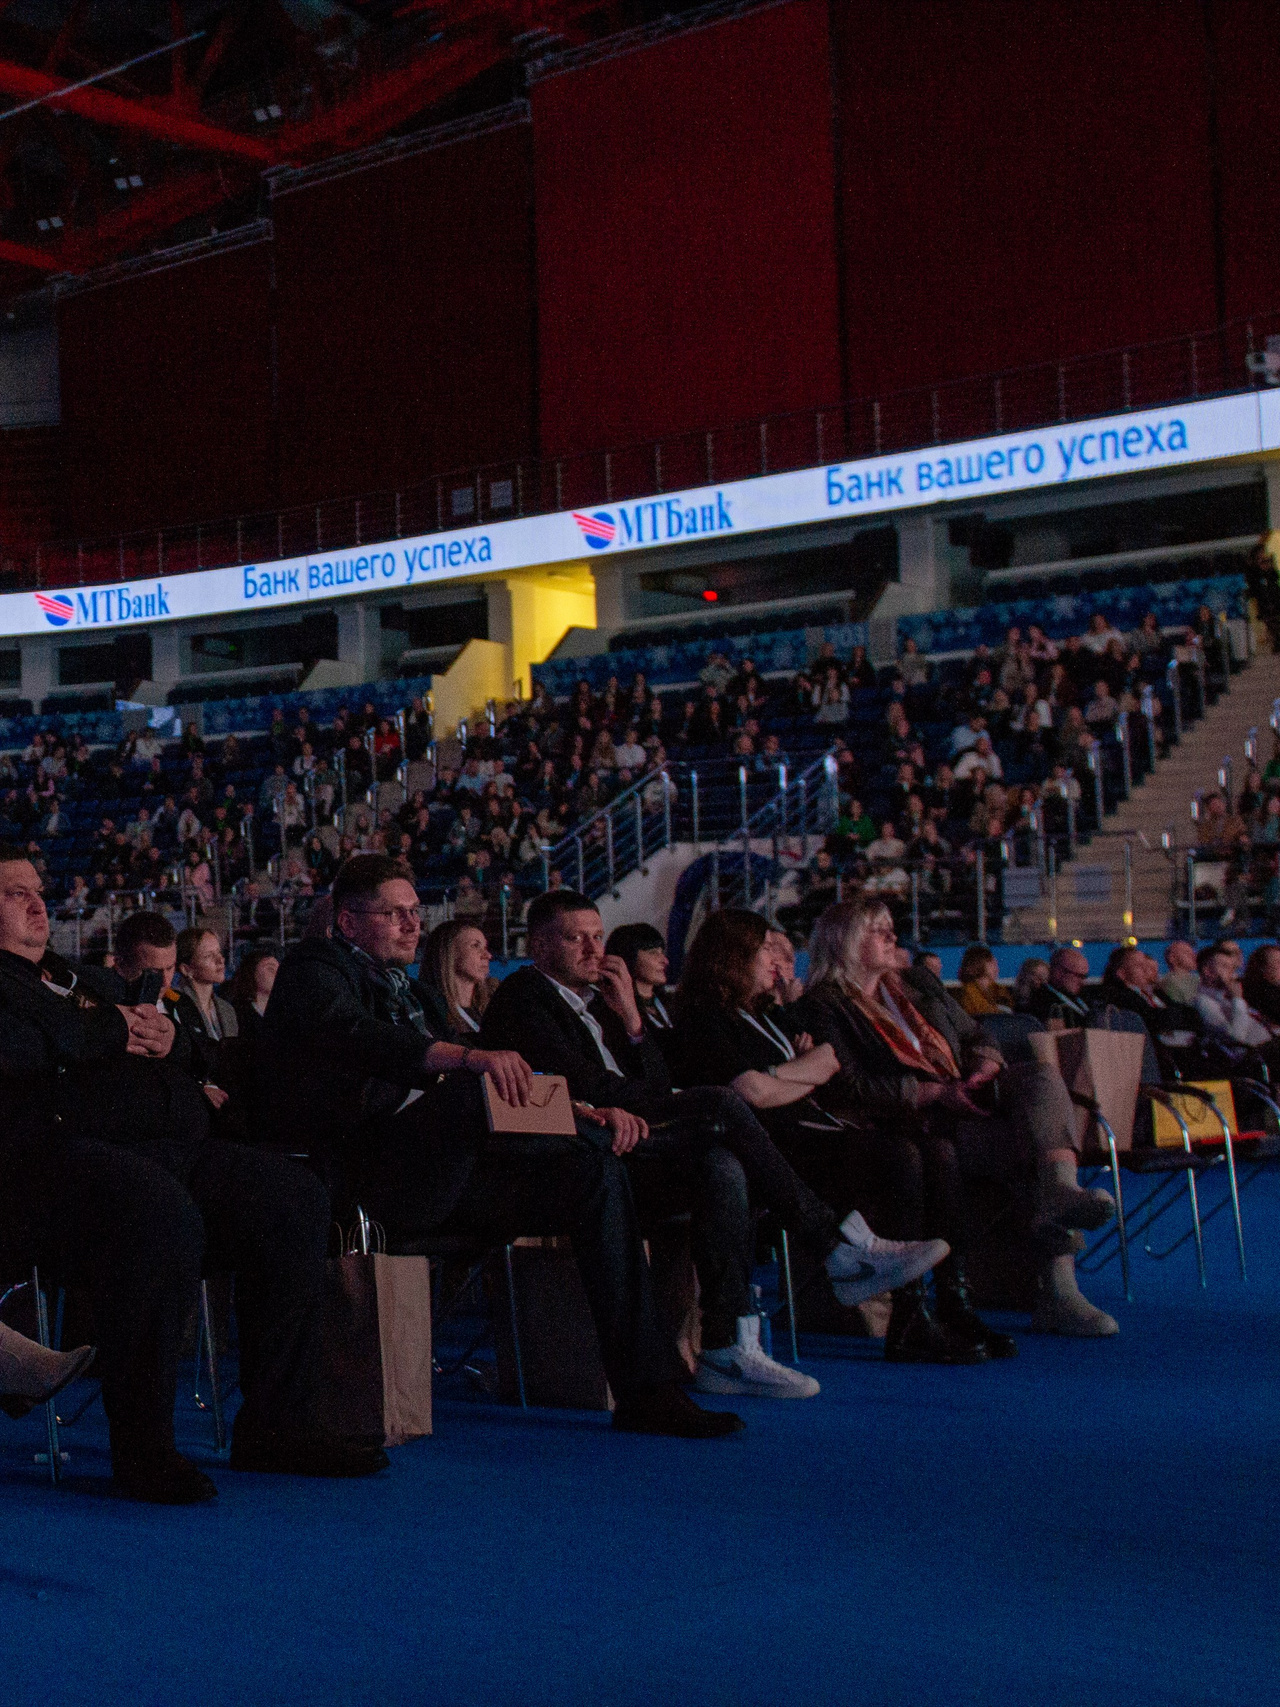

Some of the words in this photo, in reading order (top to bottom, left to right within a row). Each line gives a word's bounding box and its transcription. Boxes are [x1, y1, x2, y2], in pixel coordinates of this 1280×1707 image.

[827, 467, 904, 508] Банк
[918, 442, 1044, 491] вашего
[1057, 417, 1187, 481] успеха
[618, 492, 733, 548] МТБанк
[243, 564, 301, 600] Банк
[308, 551, 395, 589] вашего
[403, 534, 491, 582] успеха
[76, 583, 171, 626] МТБанк
